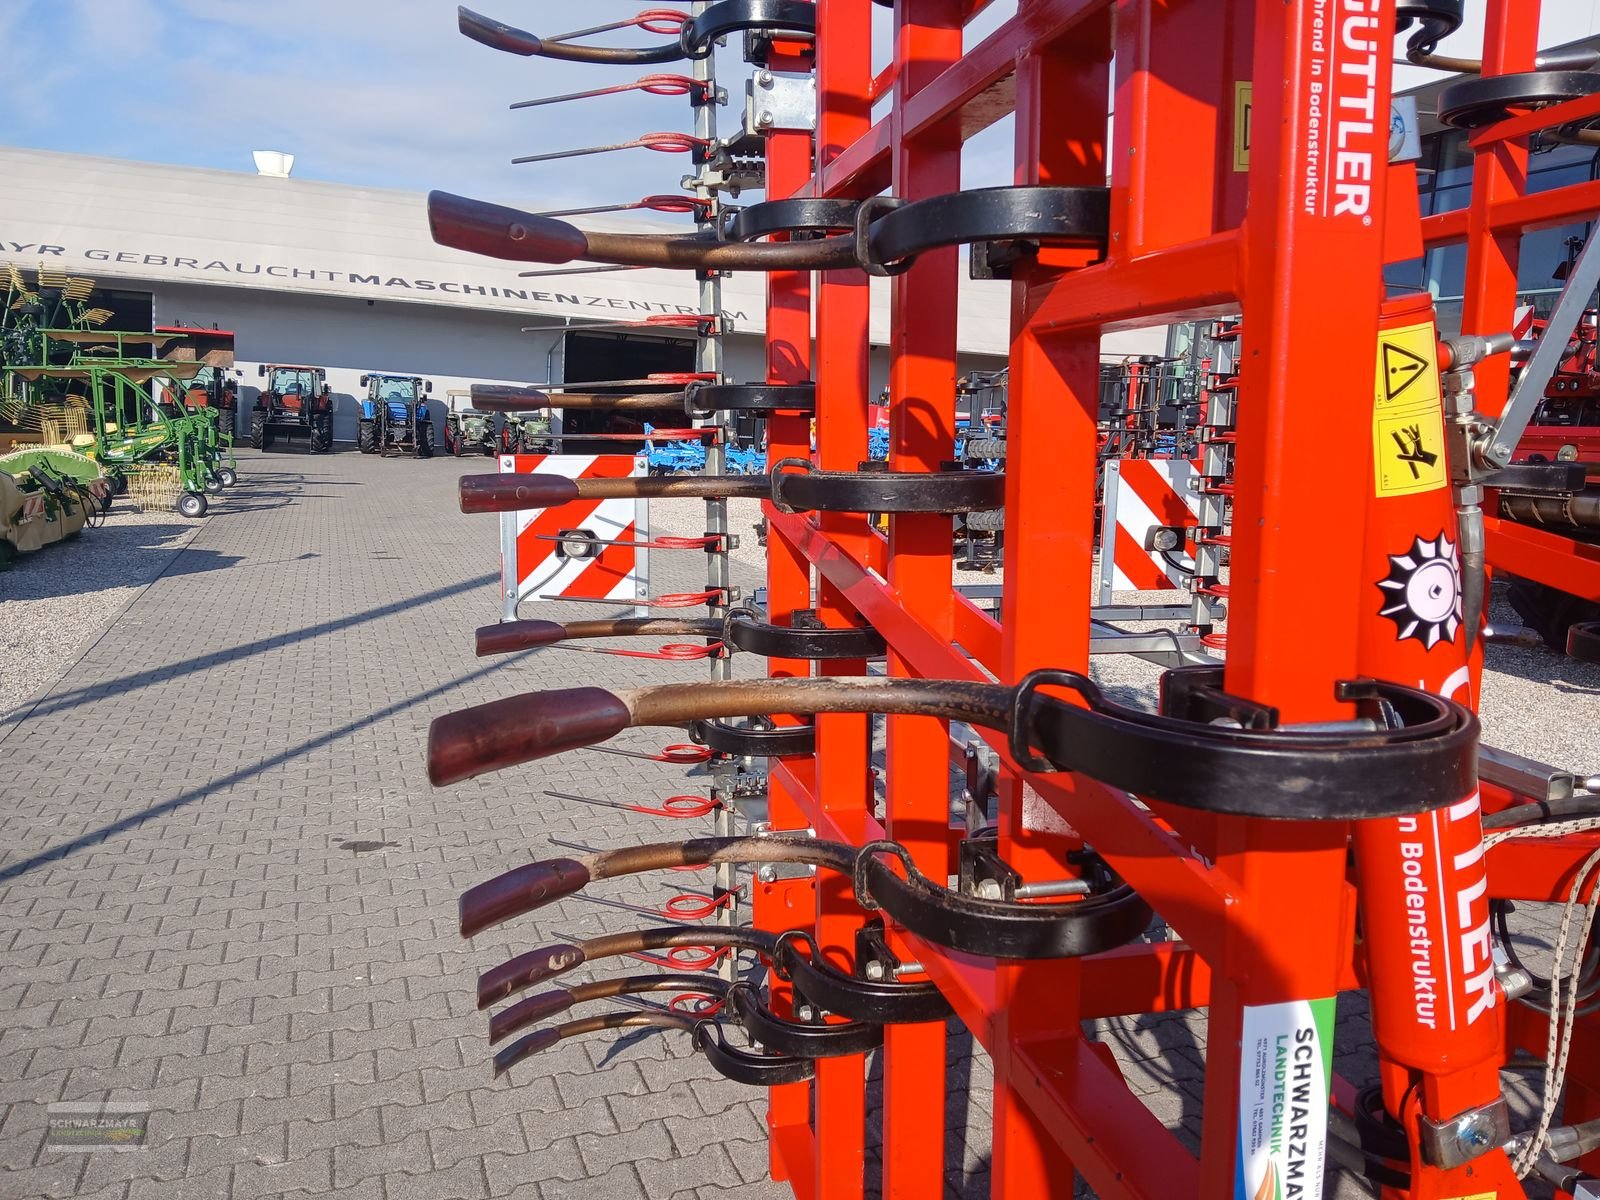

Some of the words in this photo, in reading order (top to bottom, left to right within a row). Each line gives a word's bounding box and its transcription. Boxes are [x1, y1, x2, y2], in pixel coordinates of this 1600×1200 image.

[1311, 59, 1324, 75] in
[1305, 82, 1323, 216] Bodenstruktur
[0, 241, 66, 257] YR
[84, 248, 748, 321] GEBRAUCHTMASCHINENZENTRM
[1400, 842, 1438, 1030] Bodenstruktur
[1269, 1034, 1289, 1156] LANDTECHNIK
[1286, 1028, 1315, 1200] SCHWARZMA
